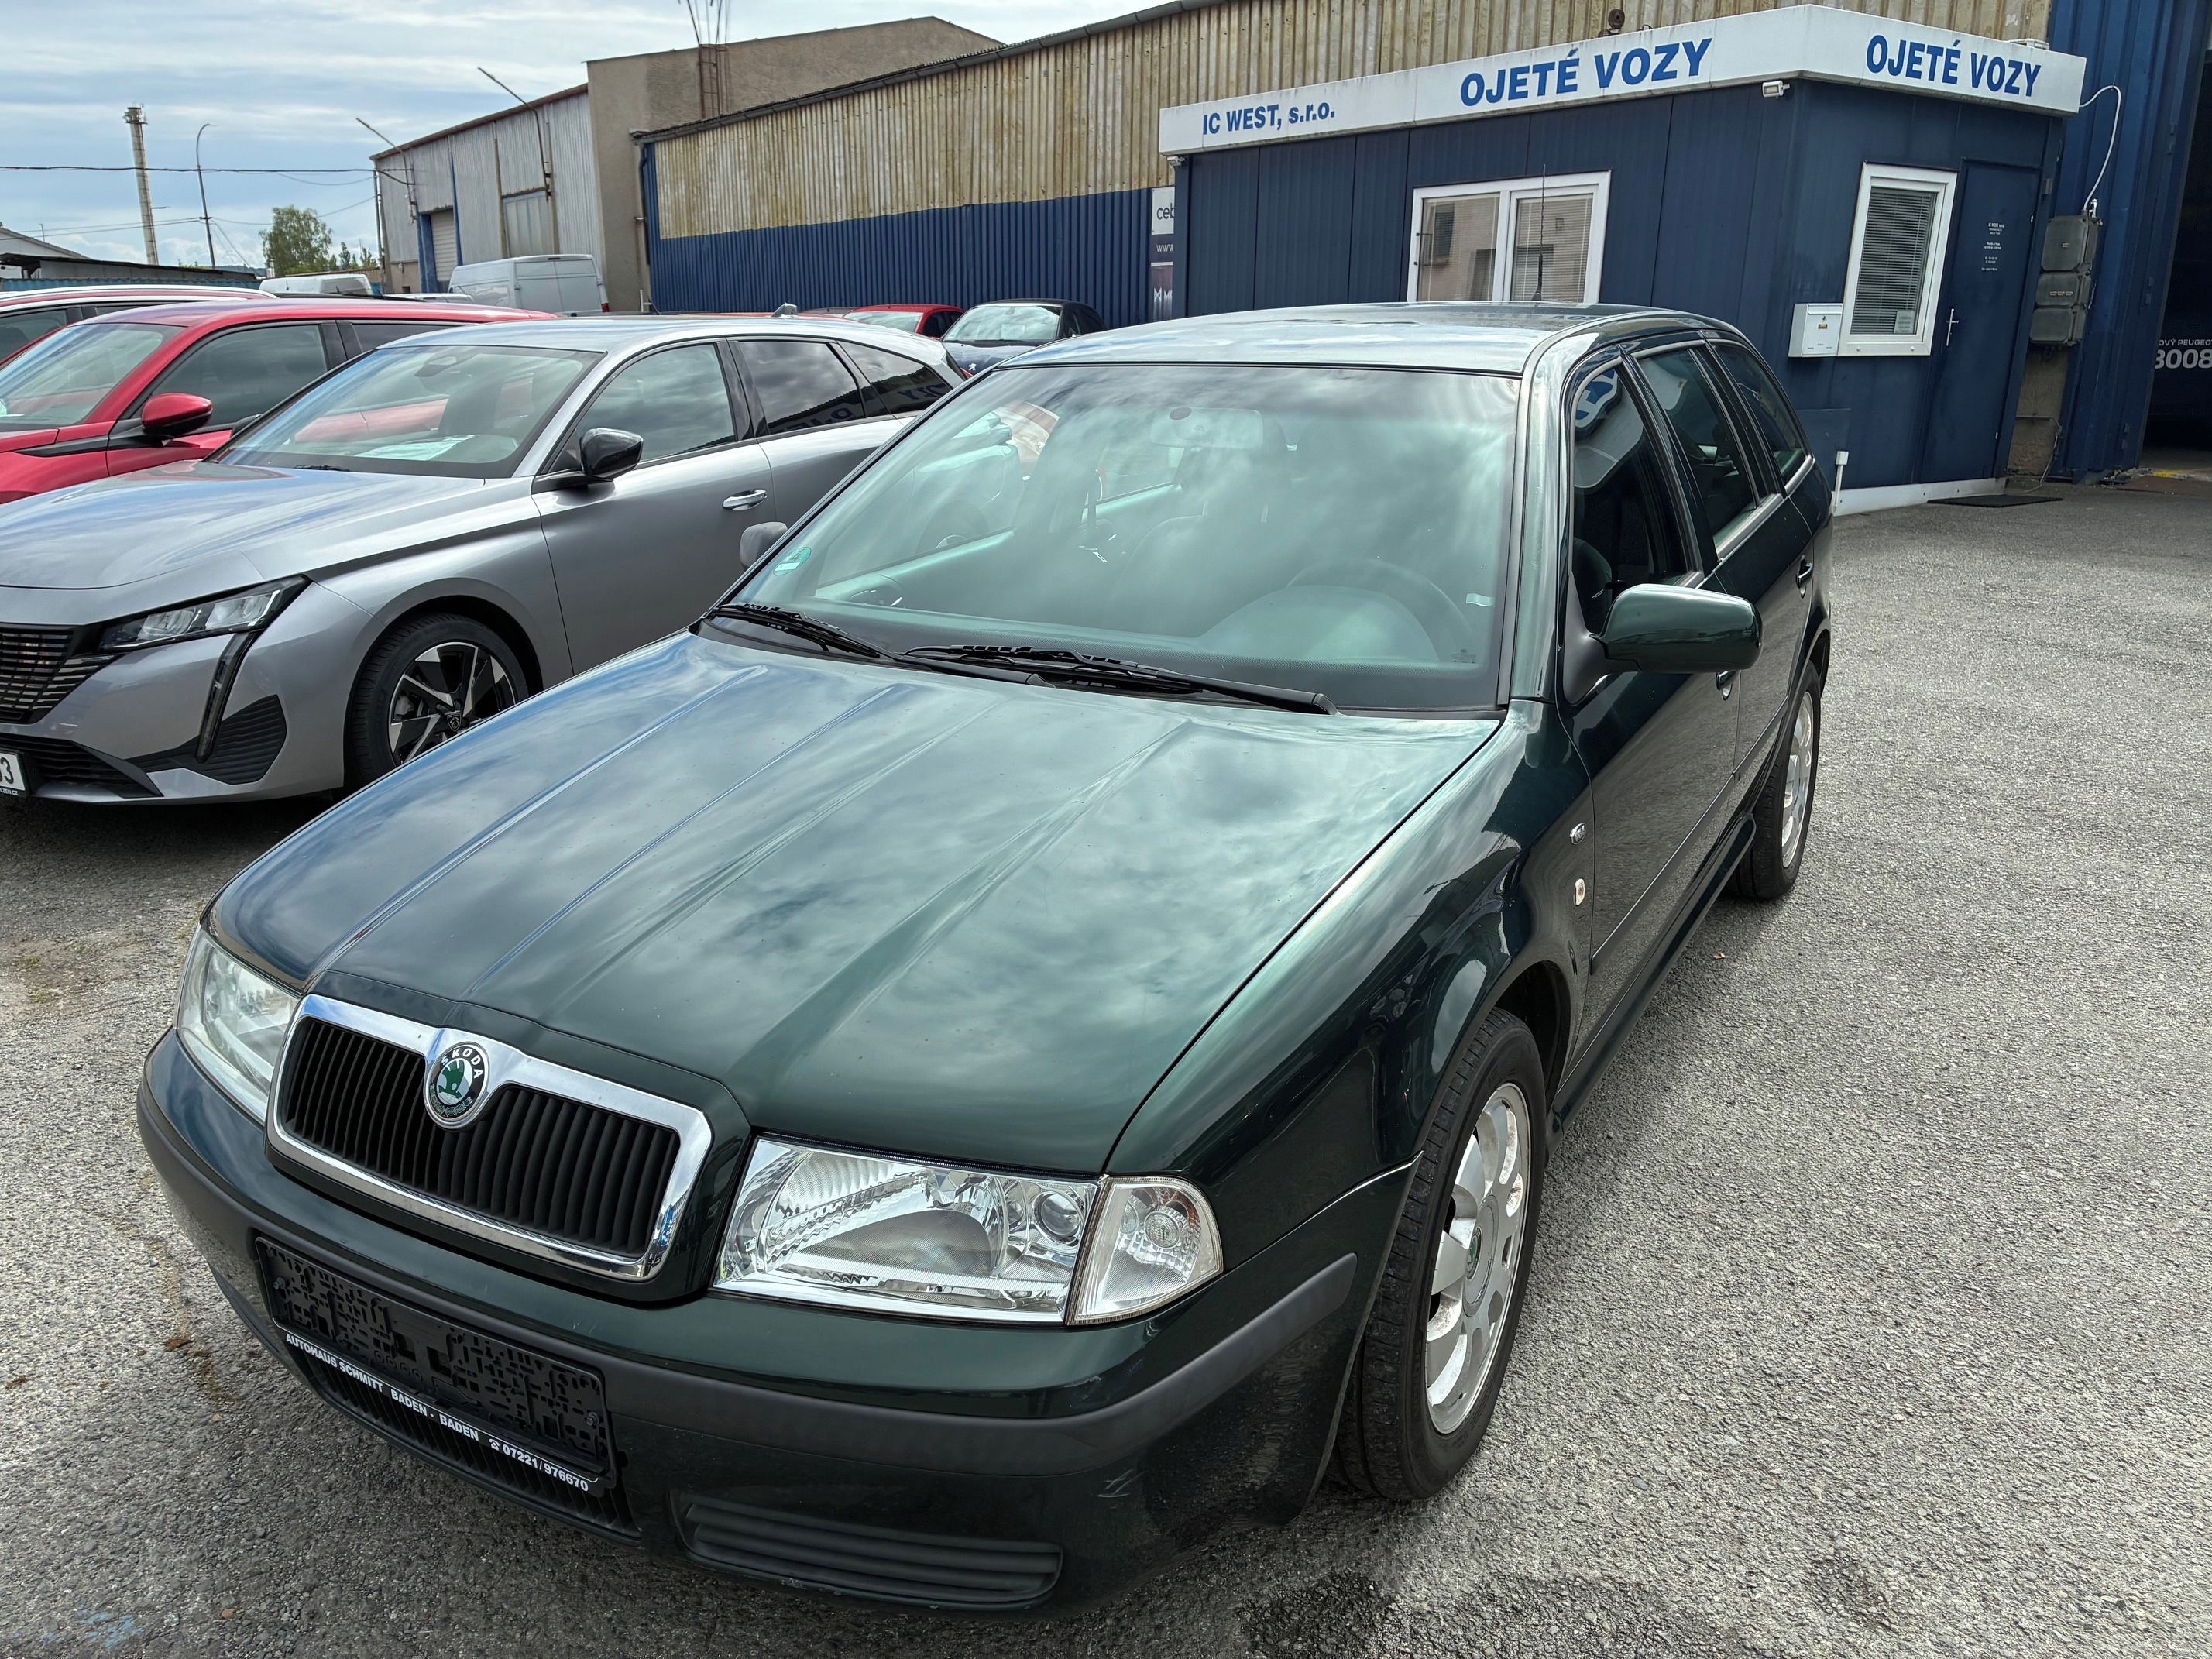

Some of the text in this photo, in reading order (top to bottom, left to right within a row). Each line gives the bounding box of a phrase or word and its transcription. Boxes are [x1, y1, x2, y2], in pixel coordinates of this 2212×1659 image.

[1460, 37, 1713, 107] OJETÉ VOZY
[1866, 34, 2042, 97] OJETÉ VOZY
[1203, 102, 1335, 135] IC WEST, s.r.o.
[2155, 349, 2212, 369] 3008
[0, 757, 14, 785] 3
[286, 1333, 338, 1368] AUTOHAUS
[338, 1361, 383, 1393] SCHMITT
[390, 1389, 428, 1417] BADEN
[438, 1413, 479, 1442] BADEN
[502, 1444, 589, 1492] 07221/976670
